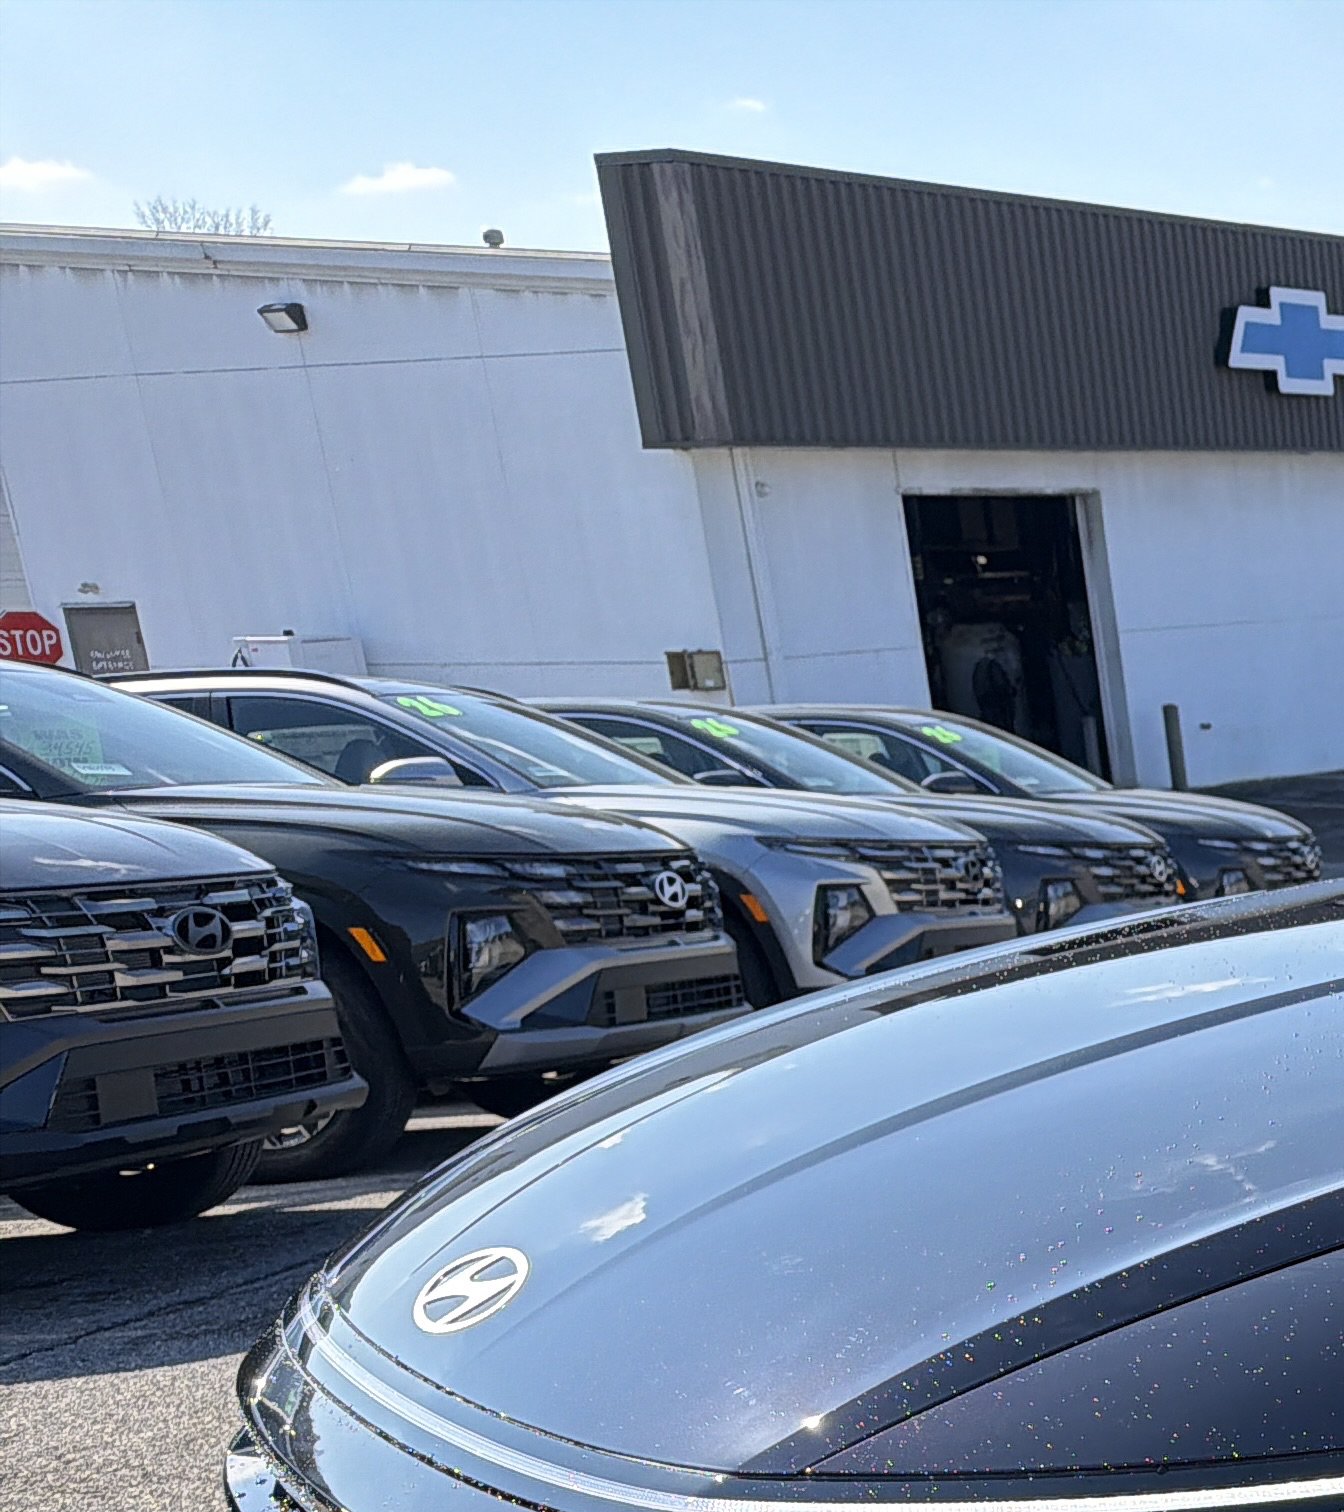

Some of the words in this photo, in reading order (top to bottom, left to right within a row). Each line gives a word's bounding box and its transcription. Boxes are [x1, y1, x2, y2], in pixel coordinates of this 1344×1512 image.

[0, 629, 57, 657] STOP
[397, 696, 463, 718] 26
[691, 717, 740, 738] 26
